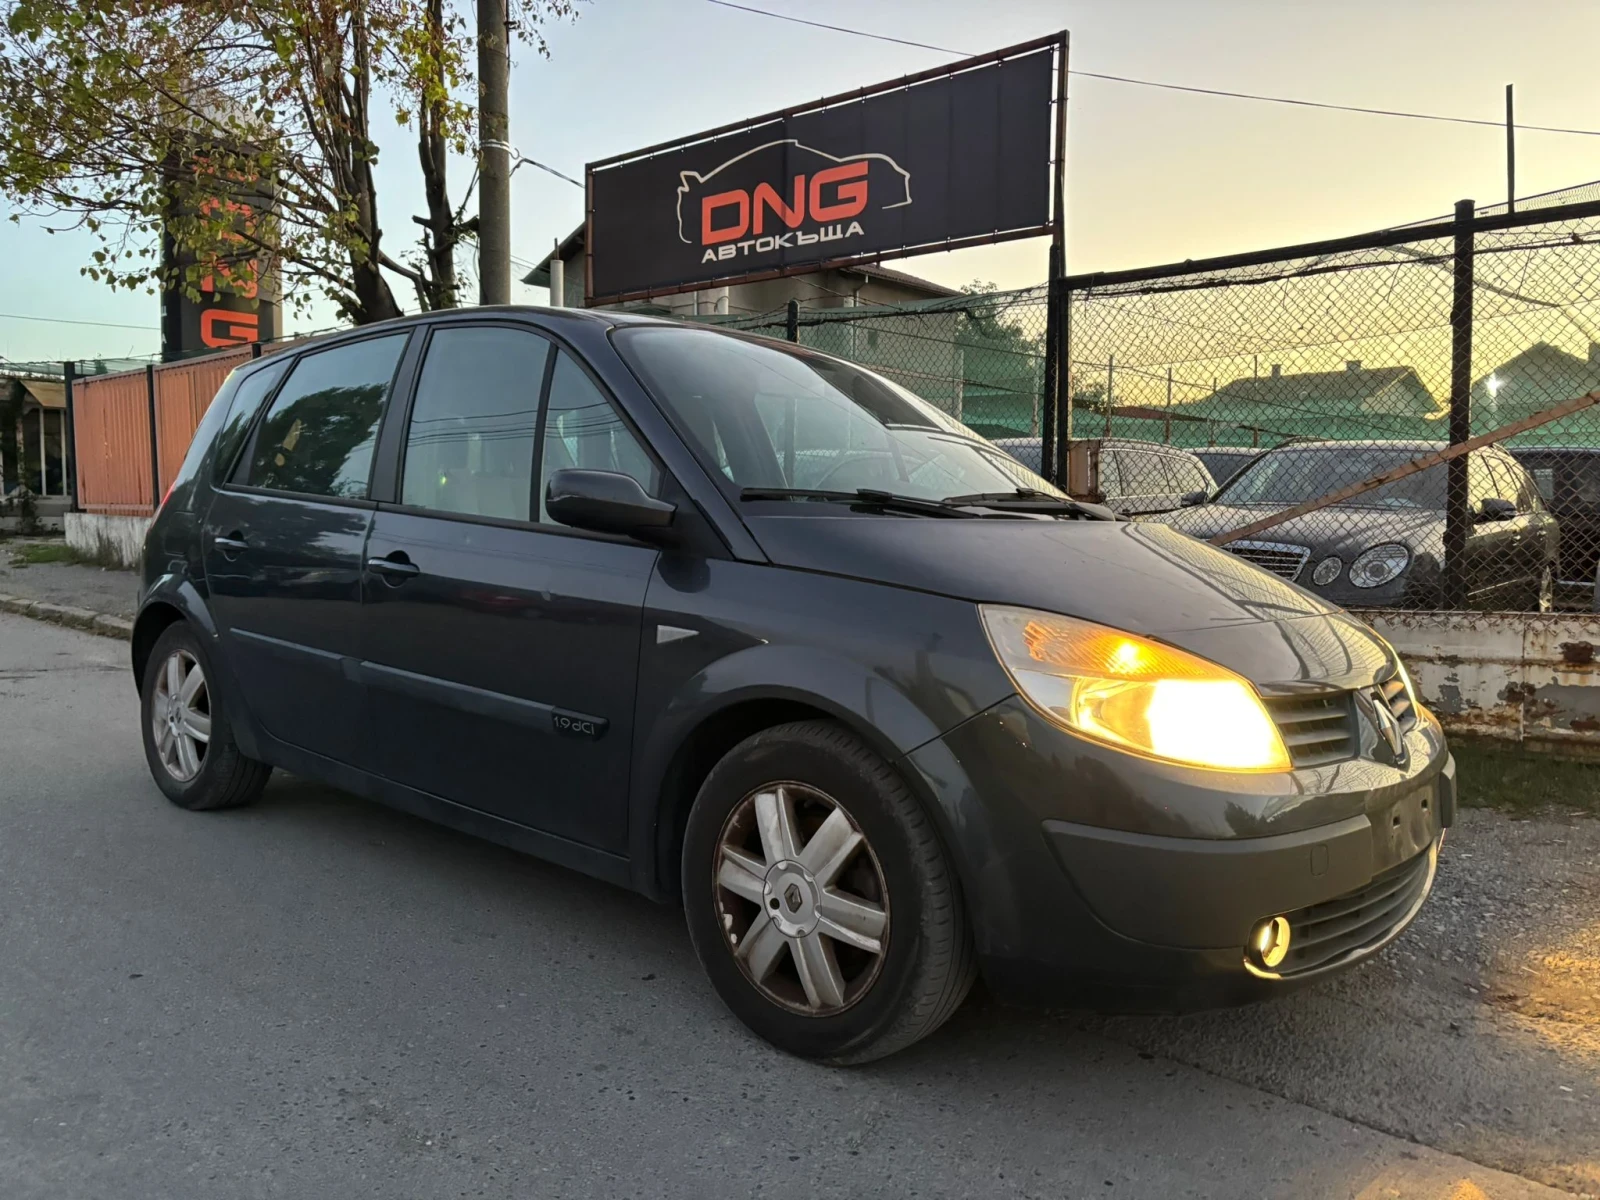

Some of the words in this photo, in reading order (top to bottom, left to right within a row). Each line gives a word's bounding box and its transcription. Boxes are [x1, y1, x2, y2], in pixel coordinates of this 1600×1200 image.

[702, 160, 868, 245] DNG
[702, 221, 864, 263] АВТОКЪЩА
[554, 716, 571, 728] 1.9
